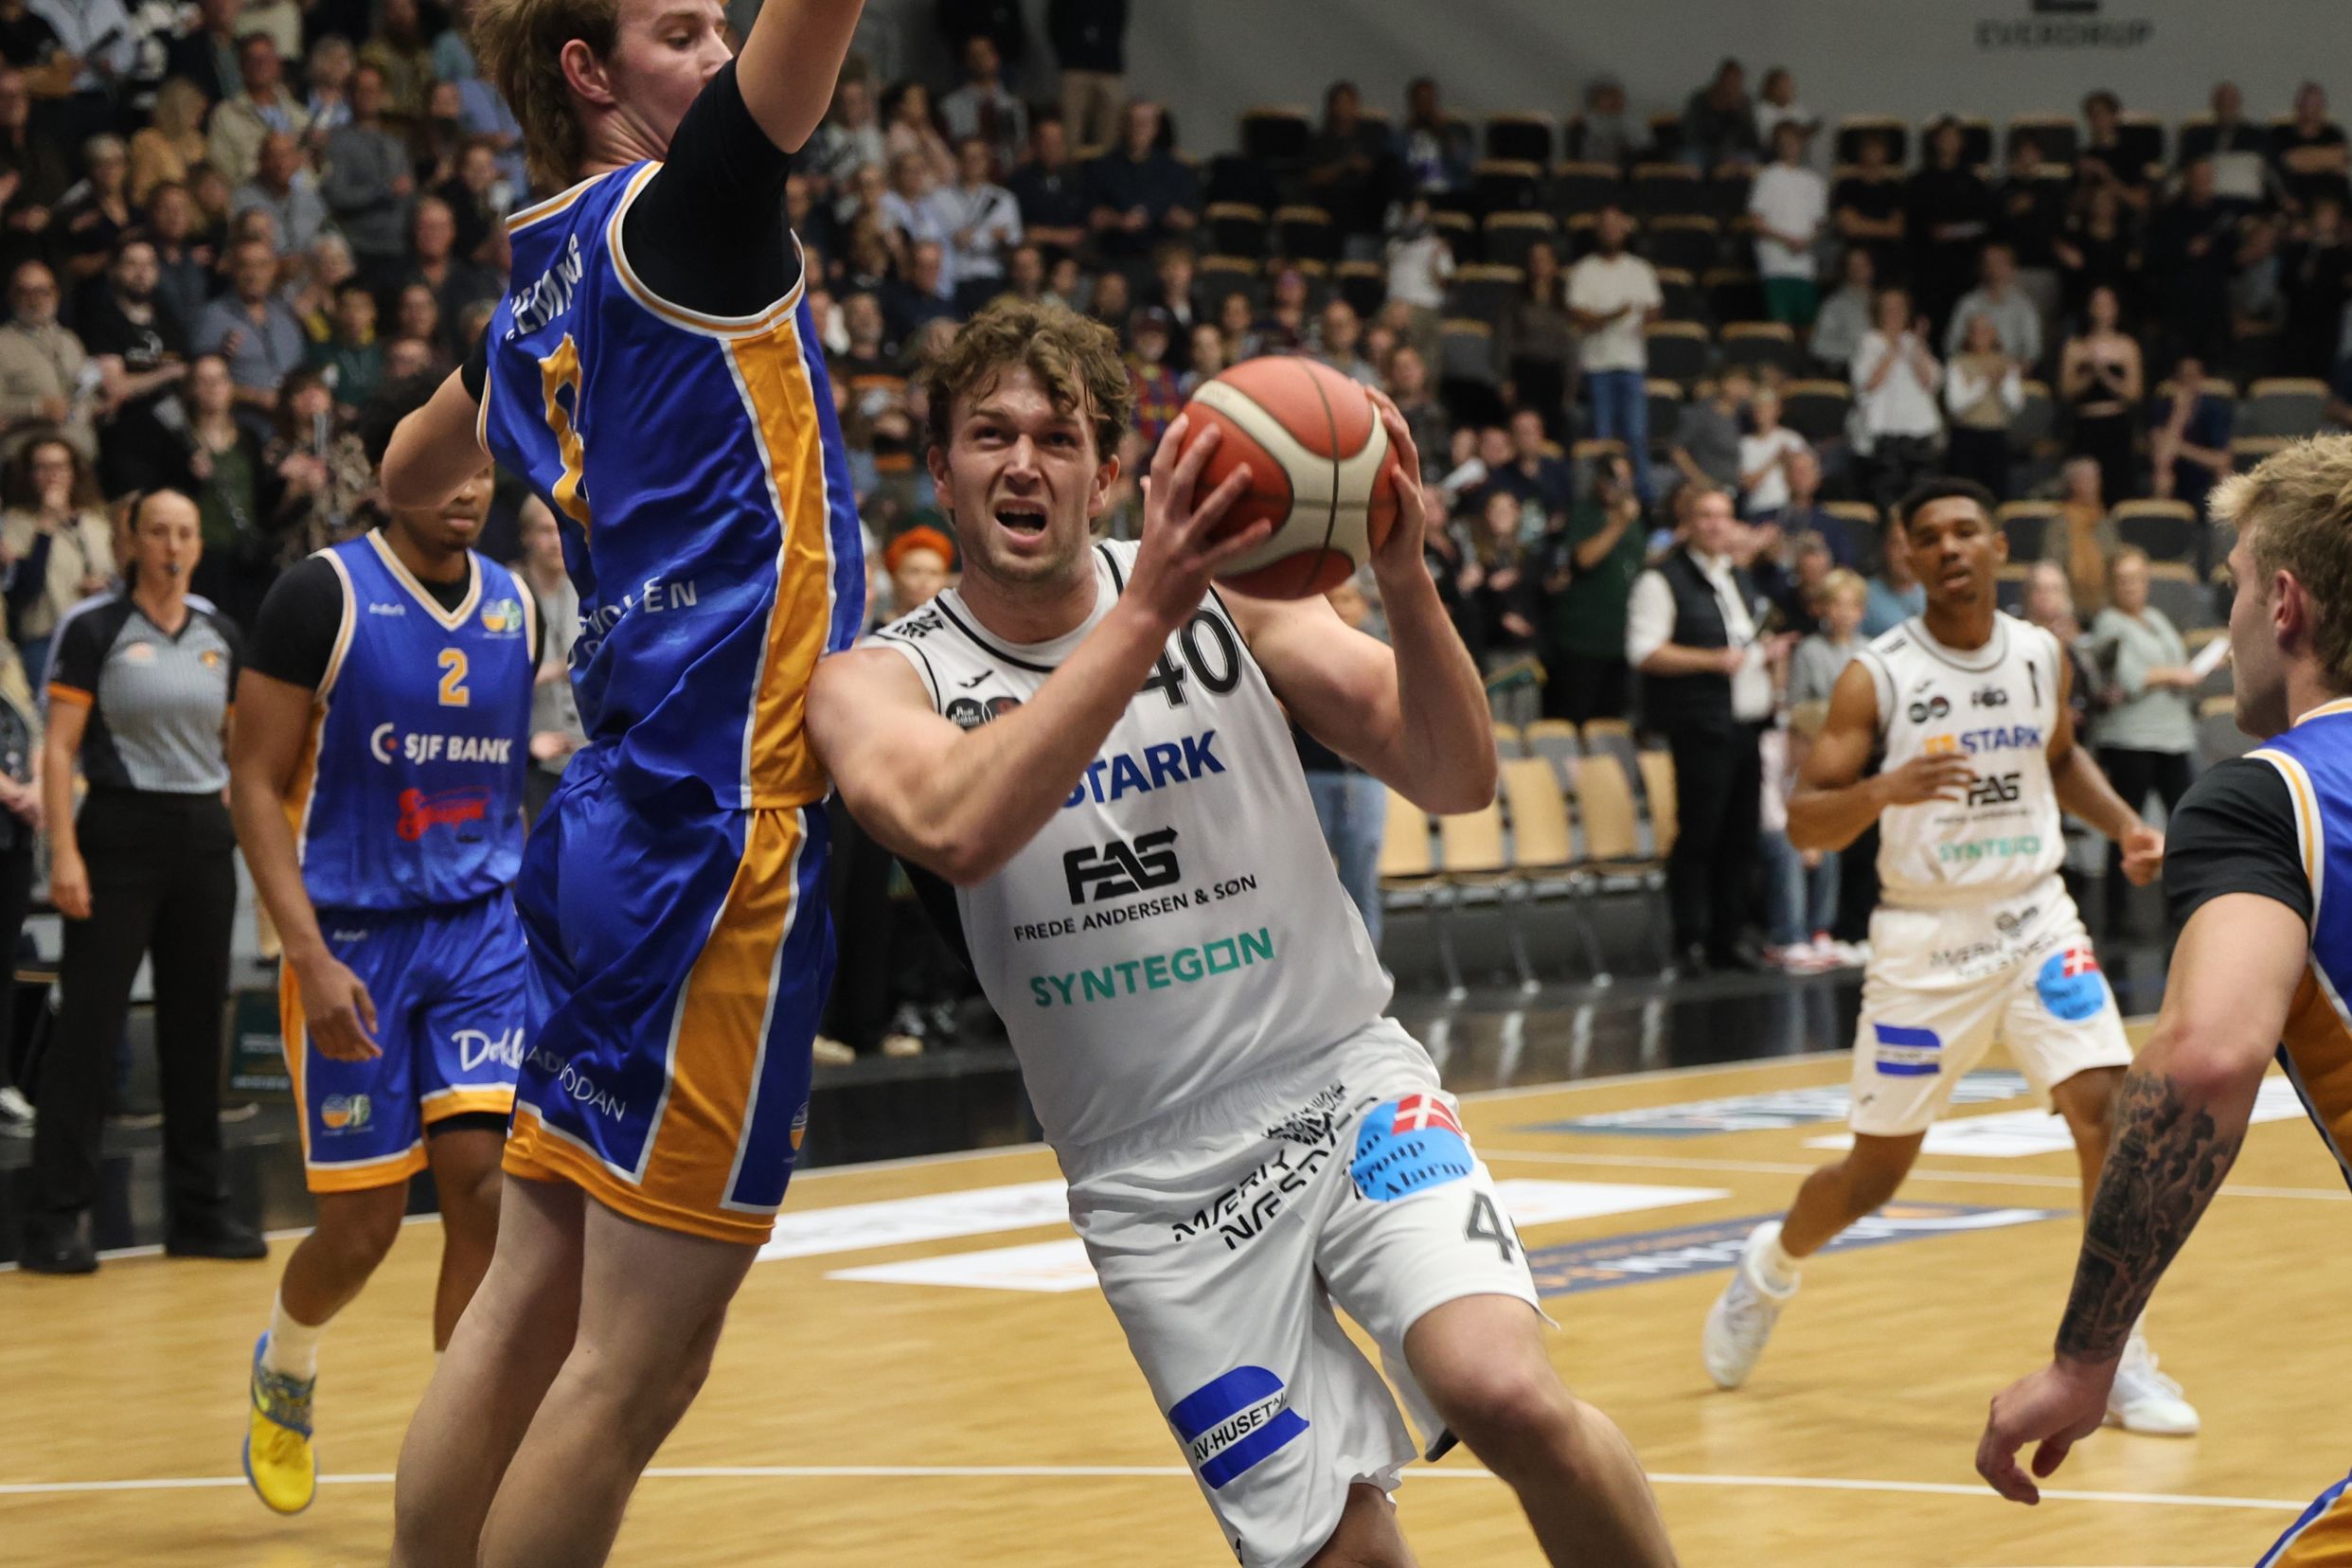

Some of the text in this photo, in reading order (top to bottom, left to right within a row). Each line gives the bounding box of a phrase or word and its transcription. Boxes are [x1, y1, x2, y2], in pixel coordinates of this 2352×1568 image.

[437, 648, 471, 707] 2
[1135, 607, 1242, 710] 40
[403, 732, 513, 765] SJF BANK
[1013, 873, 1258, 942] FREDE ANDERSEN & SØN
[1029, 927, 1276, 1008] SYNTEGON
[1464, 1189, 1529, 1266] 4
